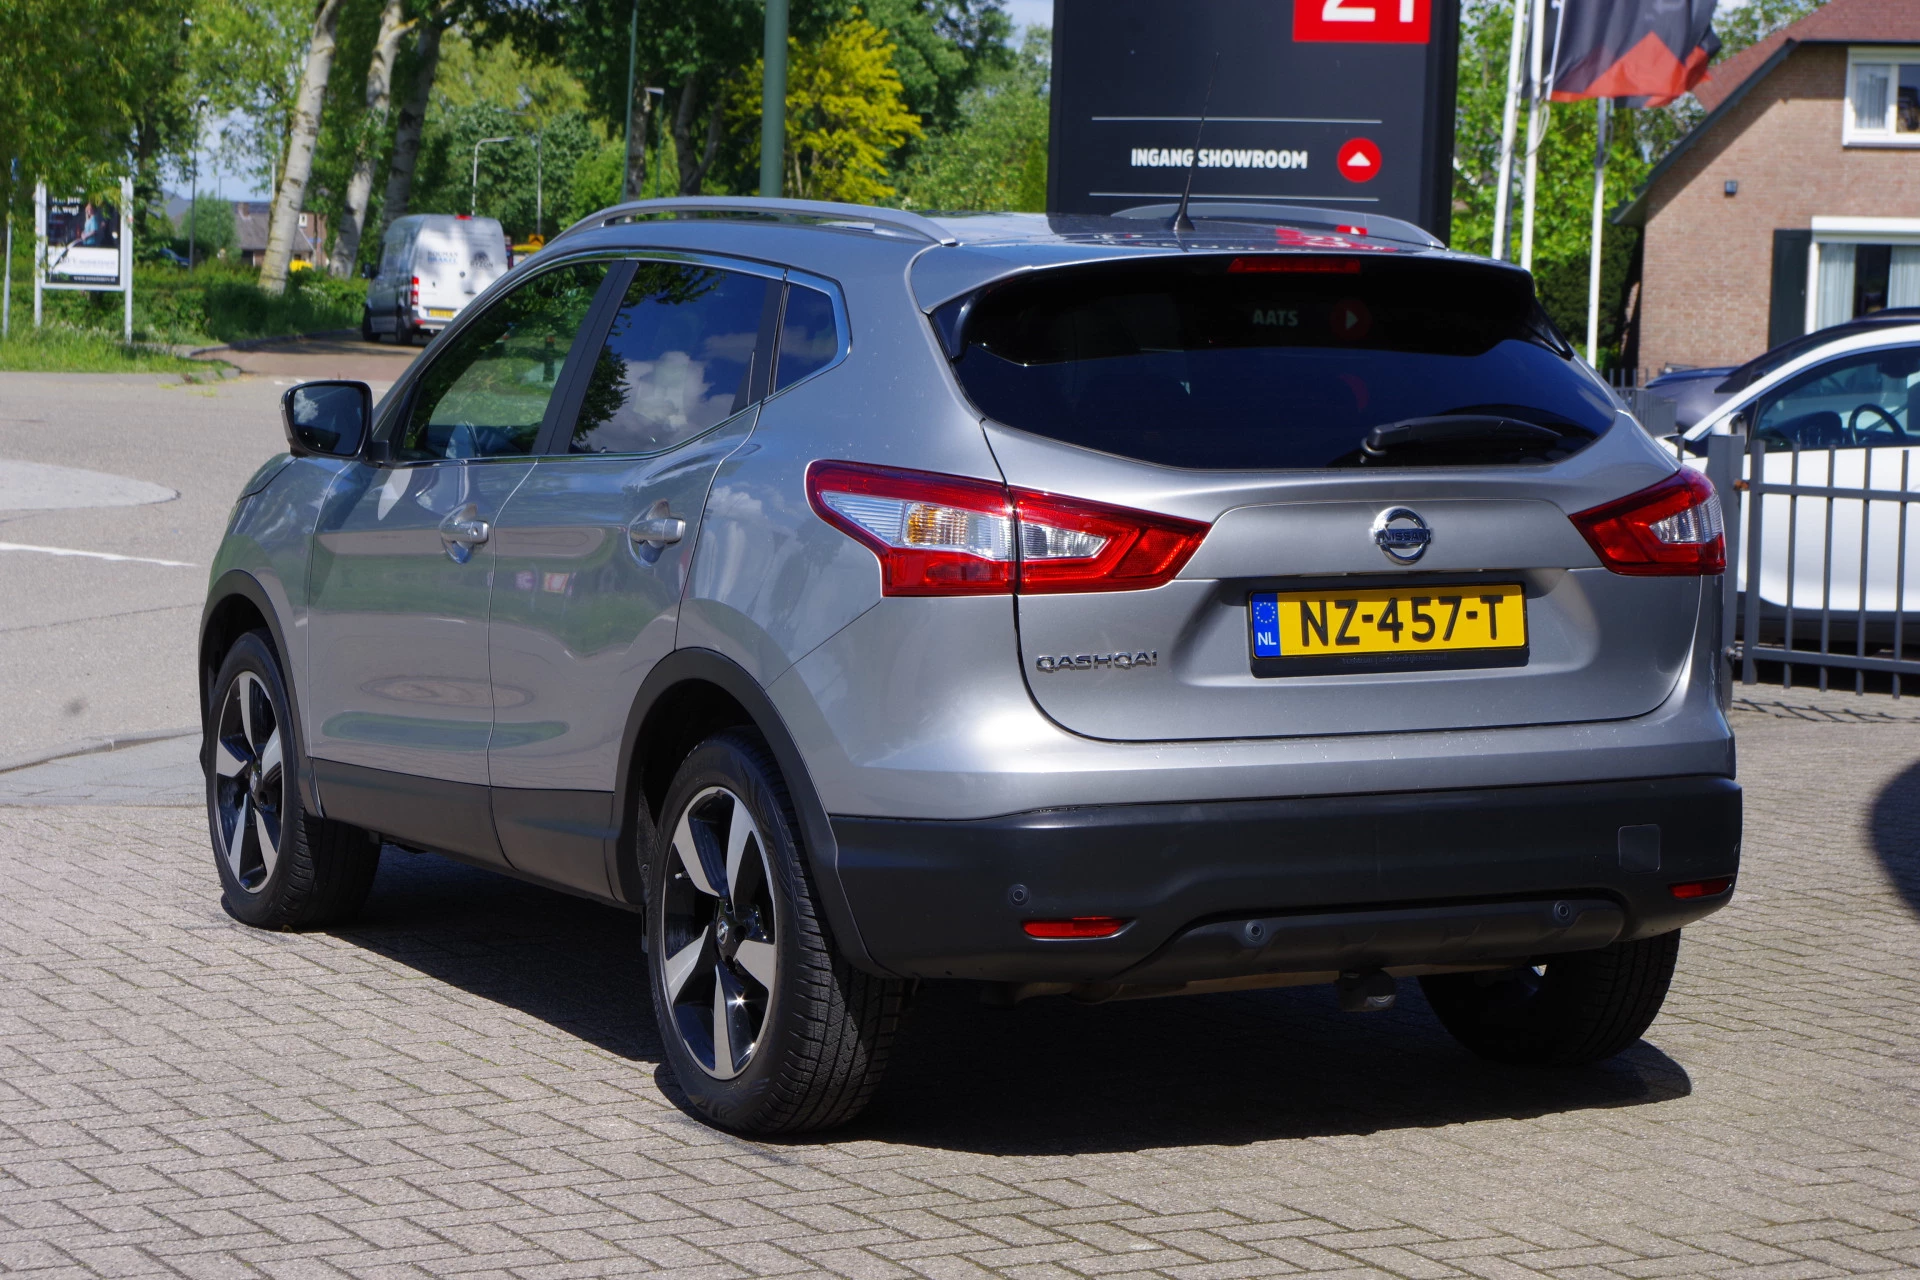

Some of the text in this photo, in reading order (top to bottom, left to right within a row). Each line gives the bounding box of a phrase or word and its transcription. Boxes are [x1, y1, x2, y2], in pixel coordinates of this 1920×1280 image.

[1131, 148, 1308, 169] INGANG SHOWROOM
[1382, 531, 1430, 542] NISSAN
[1300, 594, 1504, 647] NZ-457-T
[1257, 632, 1277, 646] NL
[1036, 649, 1158, 673] QASHQAI
